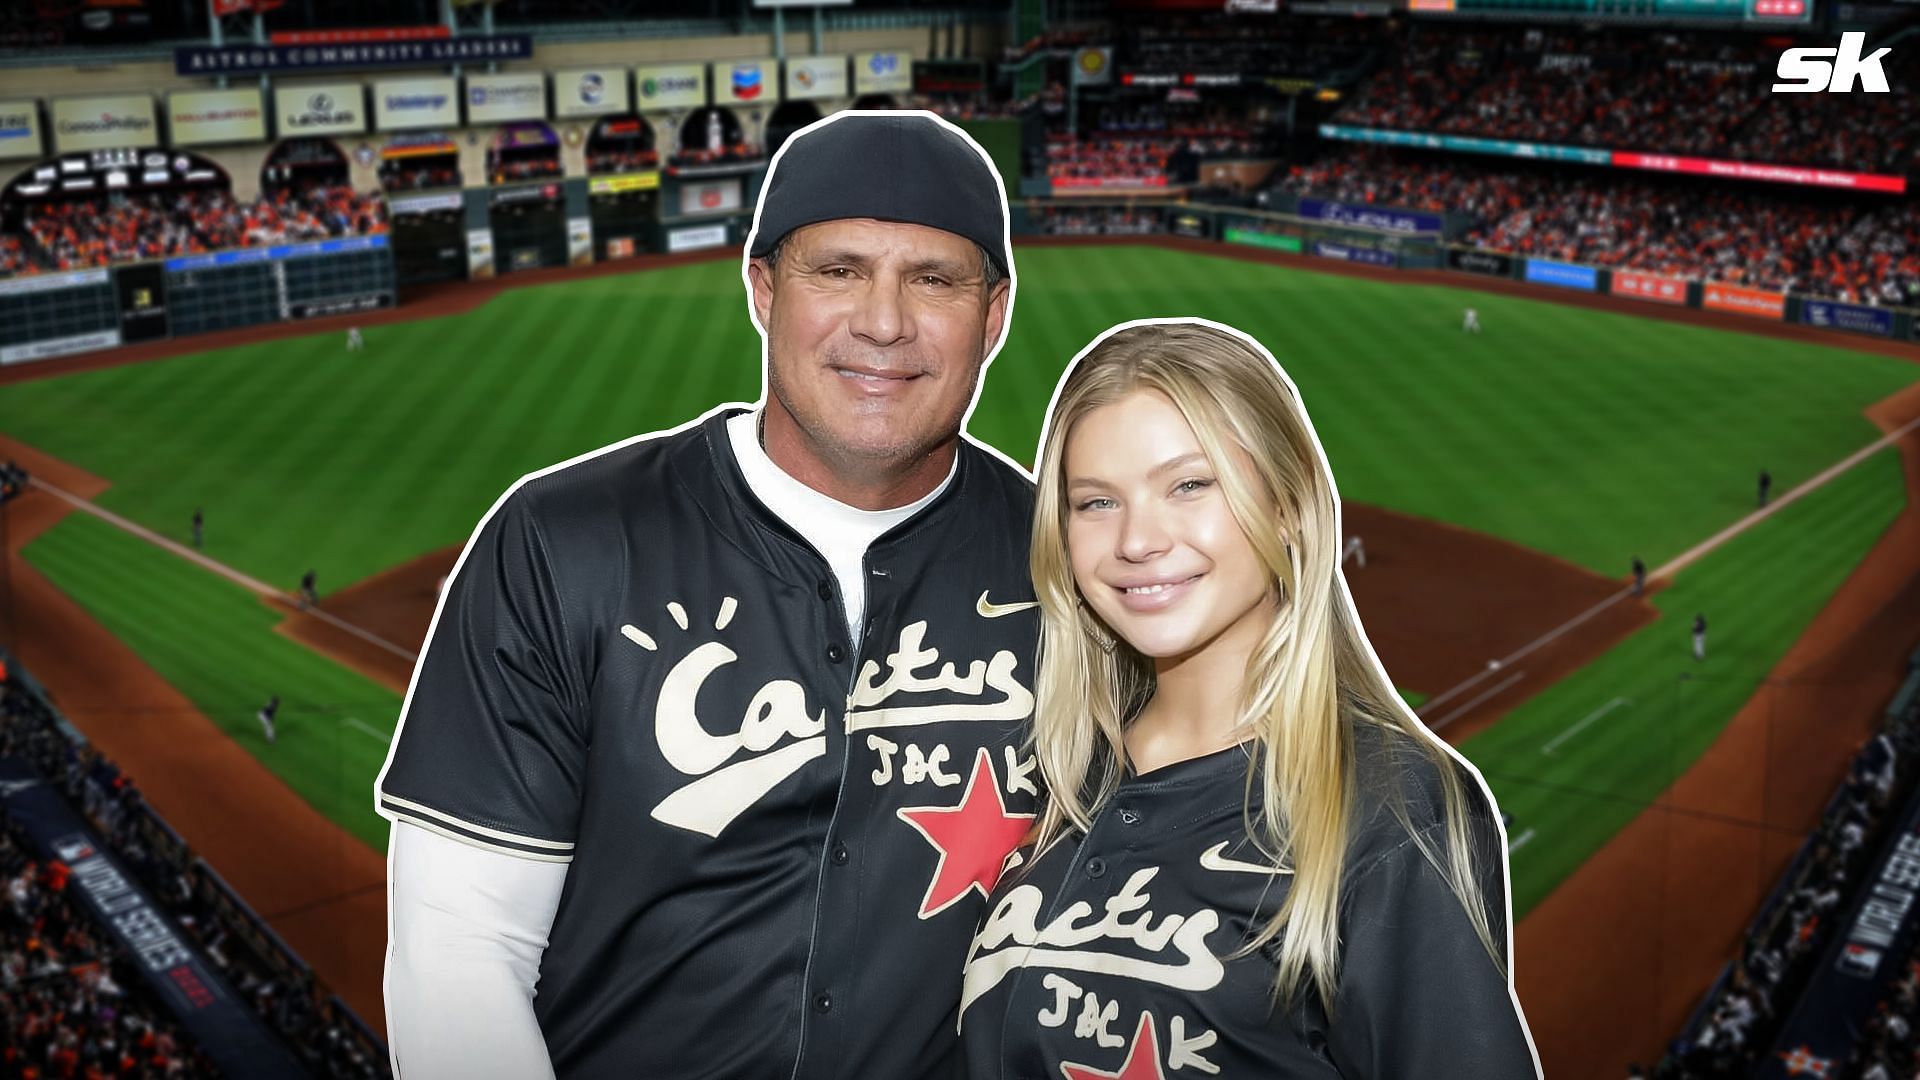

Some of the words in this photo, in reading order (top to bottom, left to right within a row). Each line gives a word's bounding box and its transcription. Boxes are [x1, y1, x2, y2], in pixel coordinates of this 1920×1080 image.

[191, 50, 279, 69] ASTROS
[288, 44, 423, 64] COMMUNITY
[433, 39, 522, 57] LEADERS
[288, 110, 355, 126] LEXUS
[71, 853, 142, 915] WORLD
[113, 906, 190, 971] SERIES
[958, 867, 1224, 1000] actus
[1850, 883, 1915, 948] WORLD
